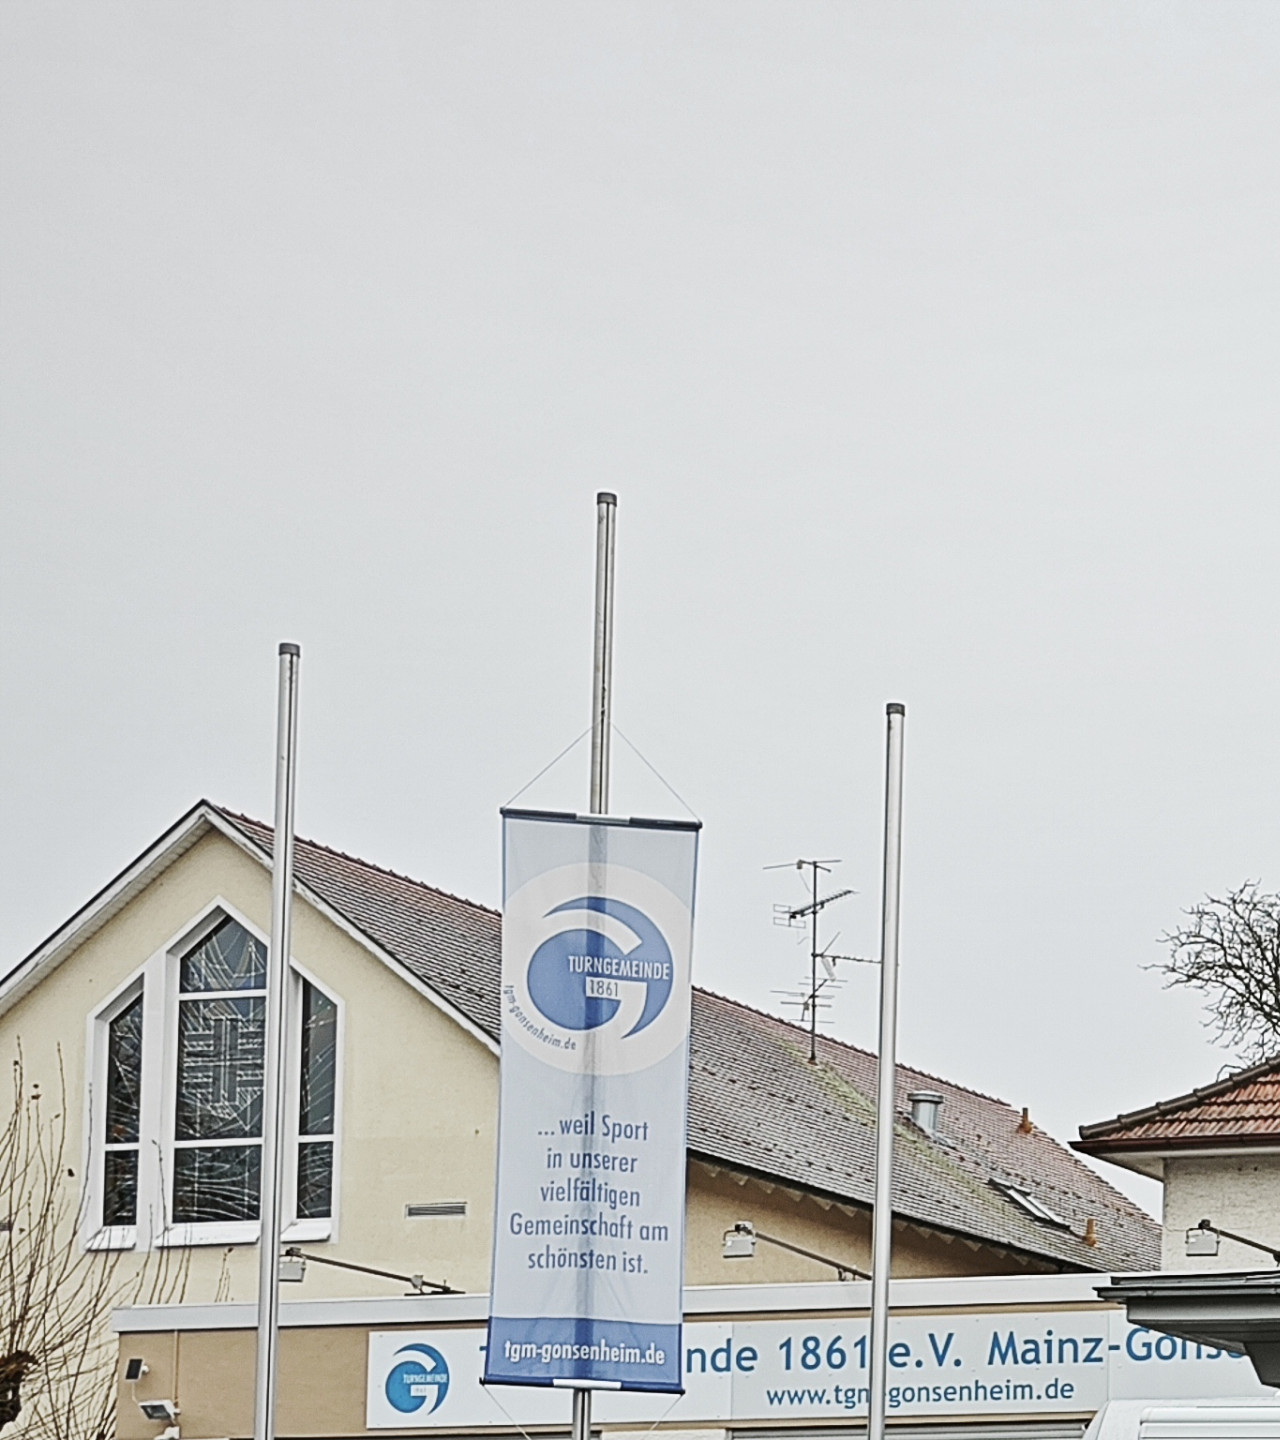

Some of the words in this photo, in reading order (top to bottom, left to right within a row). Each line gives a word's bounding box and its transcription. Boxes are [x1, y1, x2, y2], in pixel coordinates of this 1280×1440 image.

[568, 955, 670, 980] TURNGEMEINDE
[589, 980, 619, 997] 1861
[503, 984, 577, 1051] tgm-gonsenheim.de
[602, 1114, 649, 1143] Sport
[547, 1148, 562, 1169] in
[570, 1152, 638, 1173] unserer
[540, 1178, 640, 1210] vielfältigen
[510, 1212, 634, 1240] Gemeinschaft
[639, 1225, 668, 1241] am
[528, 1245, 617, 1271] schönsten
[622, 1252, 649, 1275] ist.
[504, 1339, 665, 1366] tgm-gonsenheim.de
[779, 1334, 867, 1371] 1861
[888, 1333, 964, 1368] e.V.
[987, 1327, 1244, 1366] Mainz-Gon
[767, 1378, 1074, 1410] www.tgmgonsenheim.de
